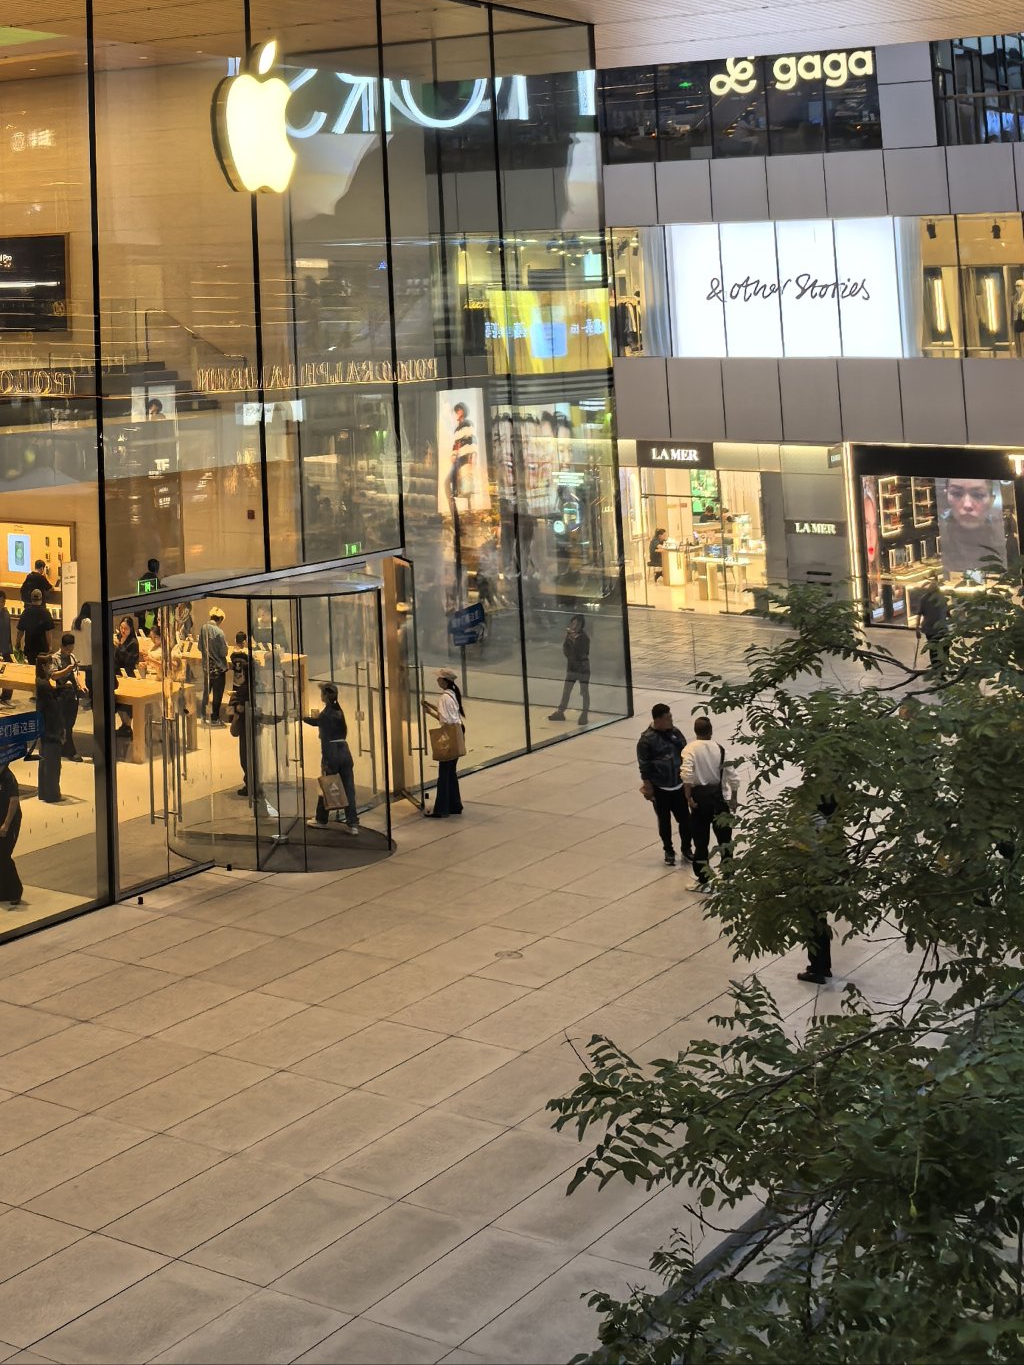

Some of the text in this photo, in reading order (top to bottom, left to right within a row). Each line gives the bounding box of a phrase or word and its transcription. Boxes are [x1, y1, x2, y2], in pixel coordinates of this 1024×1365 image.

[773, 50, 874, 91] gaga
[706, 273, 870, 303] & other Stories
[651, 448, 699, 461] LA MER
[795, 522, 836, 535] LA MER
